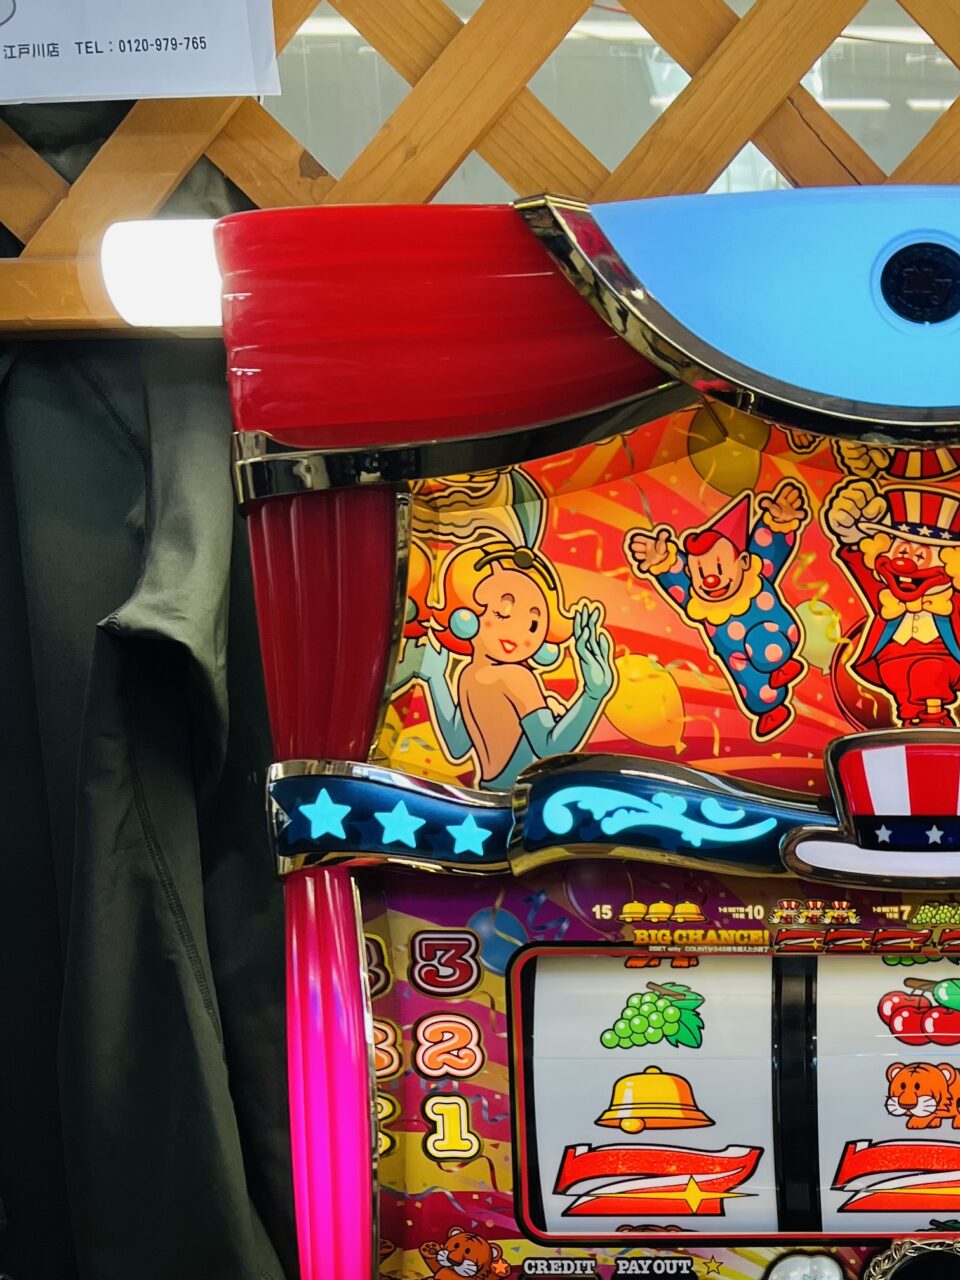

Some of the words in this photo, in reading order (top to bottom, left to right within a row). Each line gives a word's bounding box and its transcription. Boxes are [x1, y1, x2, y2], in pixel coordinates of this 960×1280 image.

[3, 43, 60, 60] 江戸川店
[592, 905, 612, 920] 15
[745, 904, 764, 920] 10
[900, 905, 912, 920] 7
[633, 929, 672, 945] BIG
[673, 929, 769, 945] CHANCE!
[410, 931, 479, 996] 3
[414, 1012, 484, 1079] 2
[424, 1094, 481, 1159] 1
[524, 1259, 596, 1275] CREDIT
